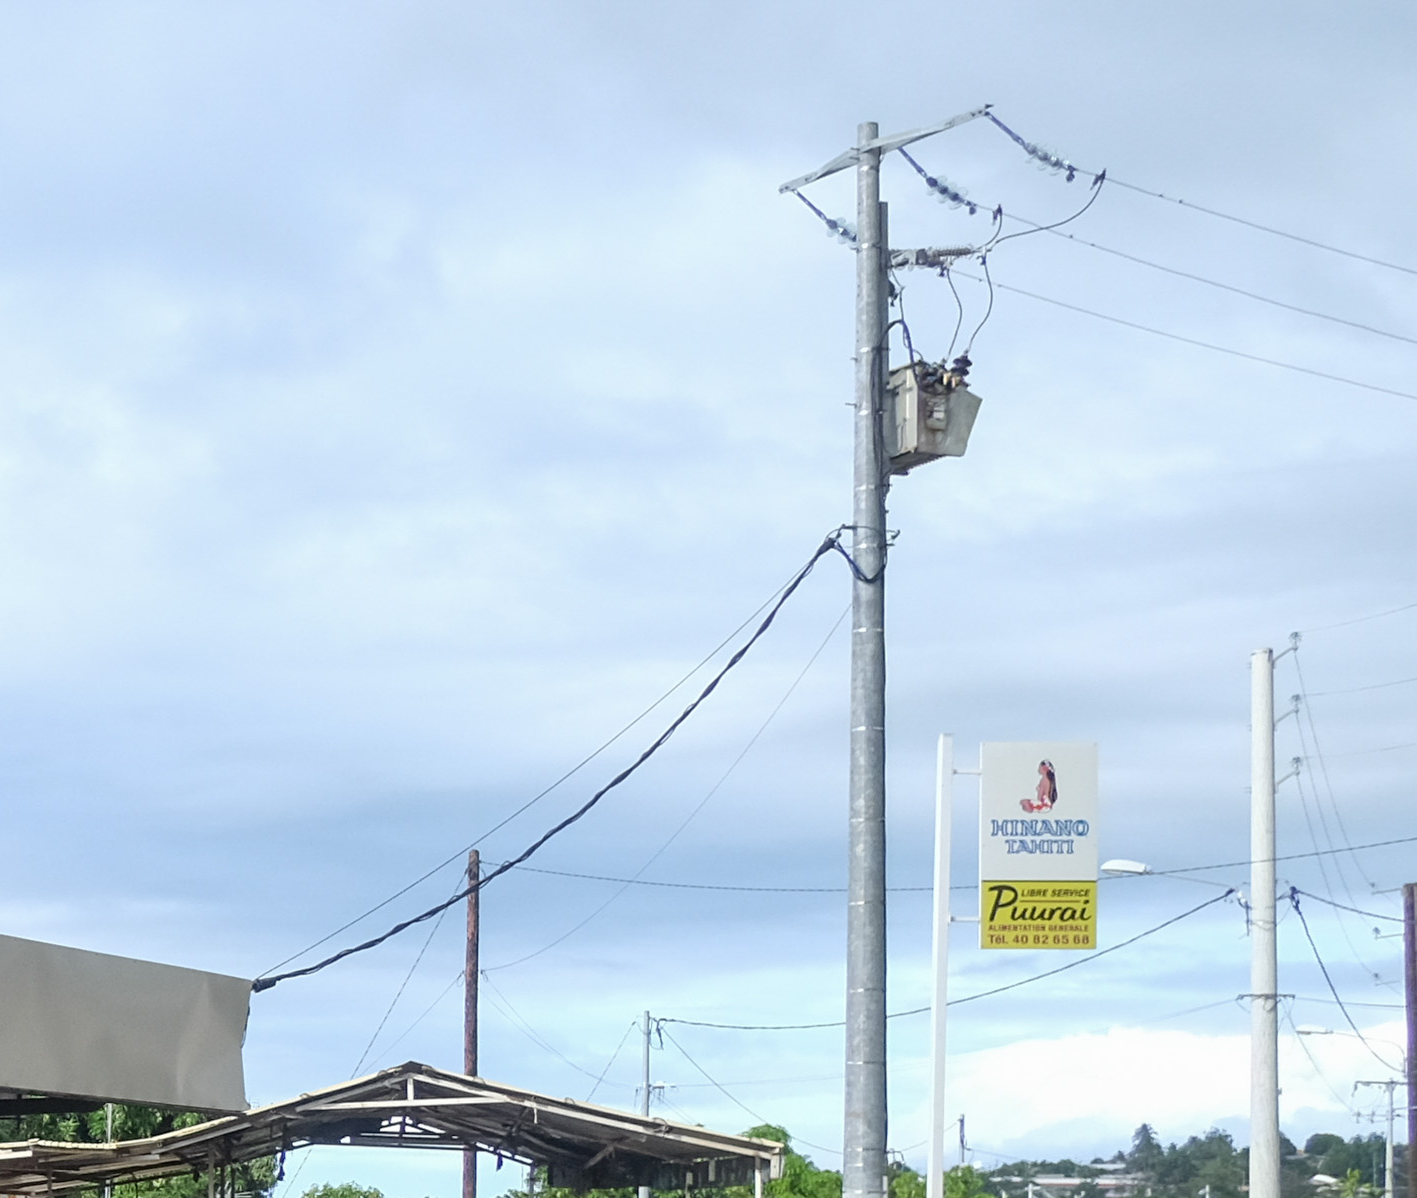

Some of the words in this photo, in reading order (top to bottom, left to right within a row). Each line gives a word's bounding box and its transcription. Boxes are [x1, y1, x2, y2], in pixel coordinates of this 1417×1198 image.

[991, 819, 1089, 837] HINANO
[1005, 839, 1074, 854] TAHITI
[1021, 889, 1049, 897] LIBRE
[1051, 889, 1090, 897] SERVICE
[988, 885, 1091, 922] Puurai
[989, 924, 1045, 932] ALIMENTATION
[1013, 934, 1028, 945] 40
[1033, 934, 1049, 945] 82
